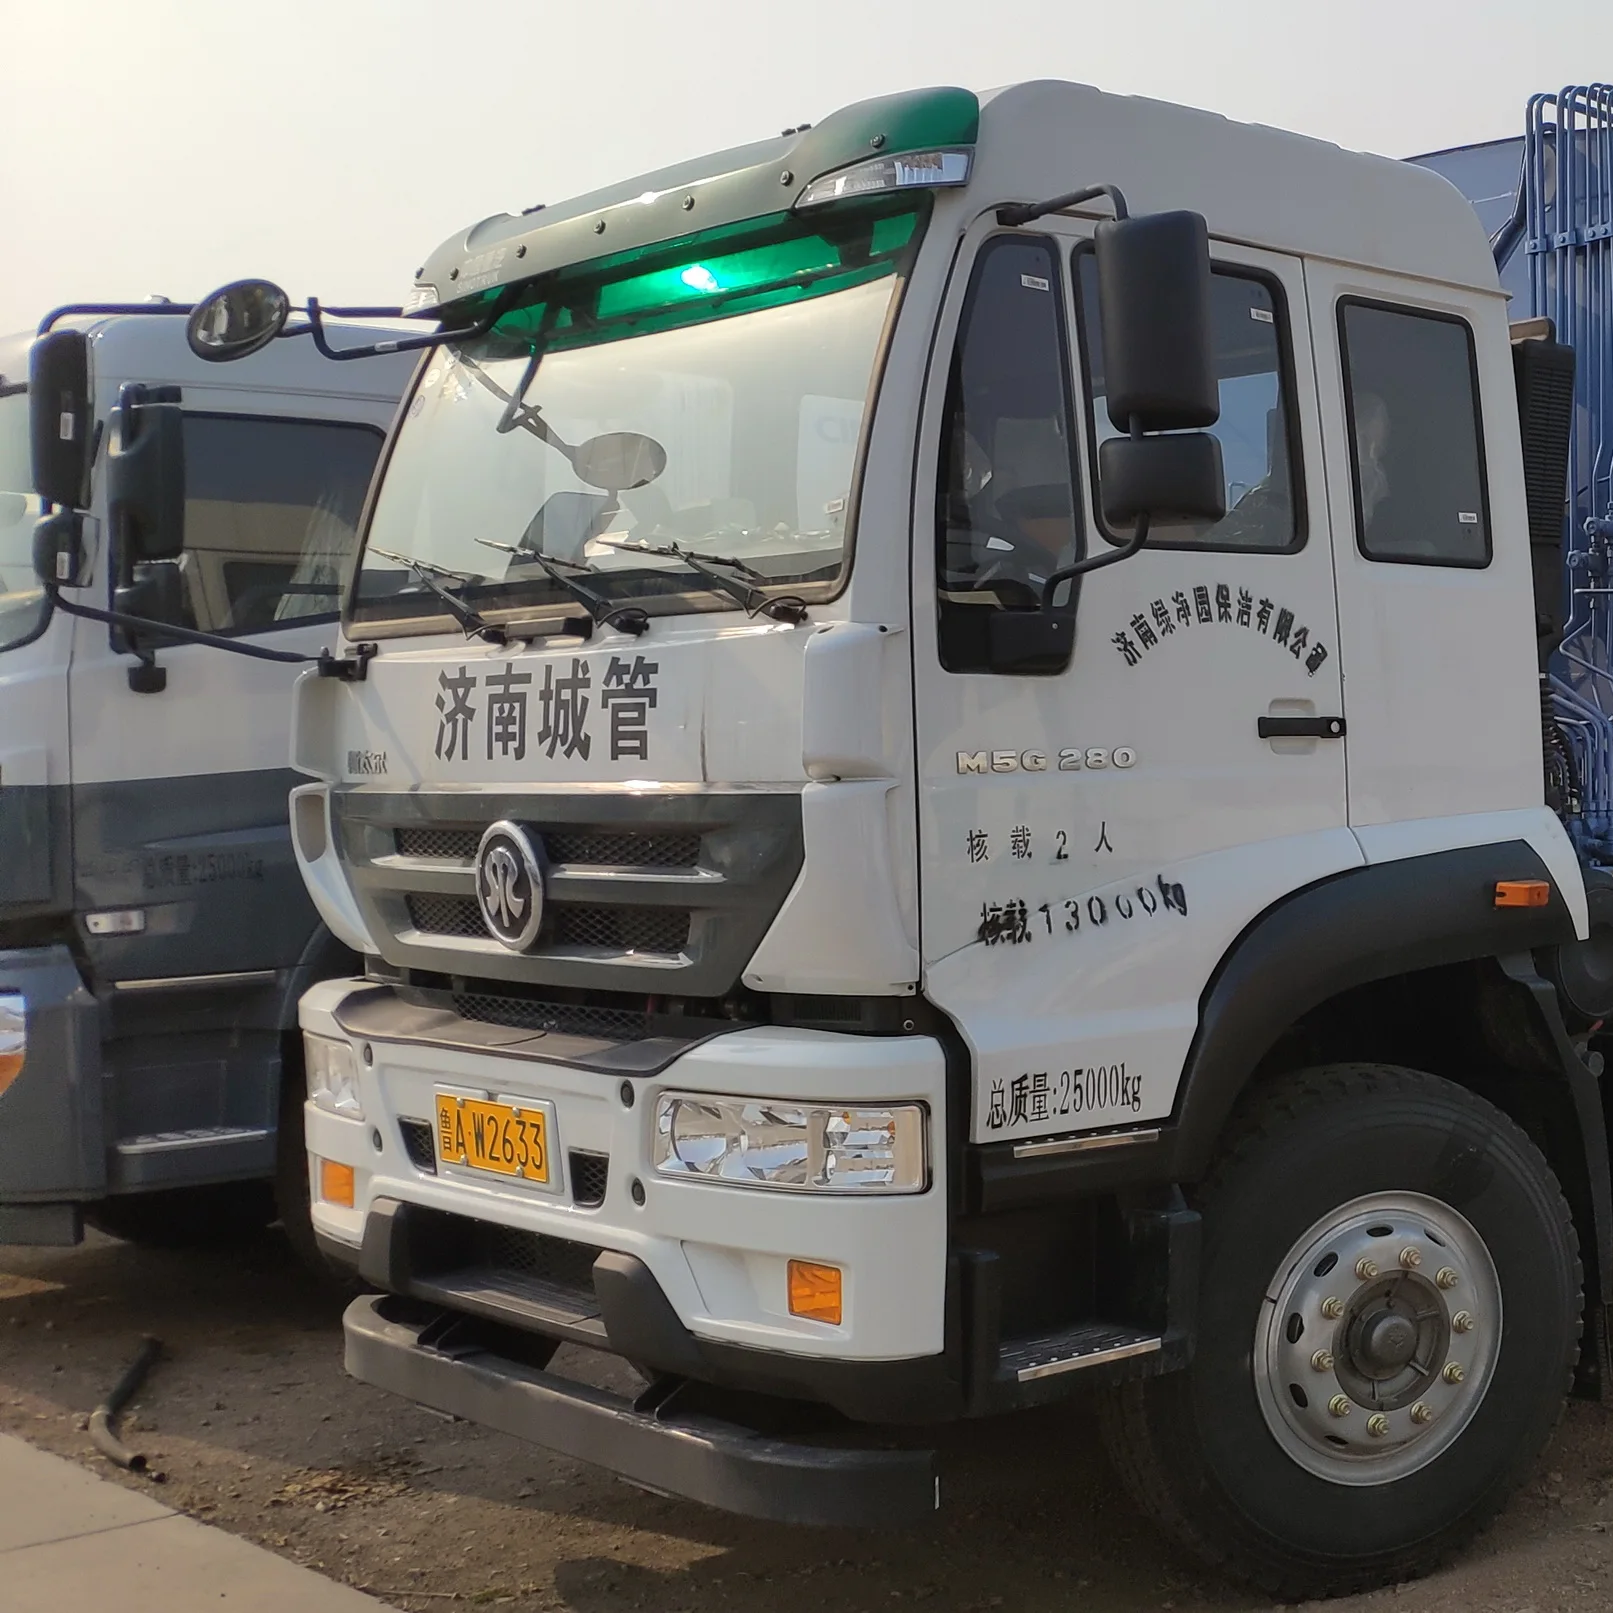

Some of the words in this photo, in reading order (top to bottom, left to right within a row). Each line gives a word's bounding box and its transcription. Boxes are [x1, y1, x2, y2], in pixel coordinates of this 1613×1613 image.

[434, 655, 659, 762] 济南城管
[956, 750, 1048, 775] M5G
[1058, 747, 1138, 771] 280
[986, 1062, 1142, 1130] 总质量:25000kg
